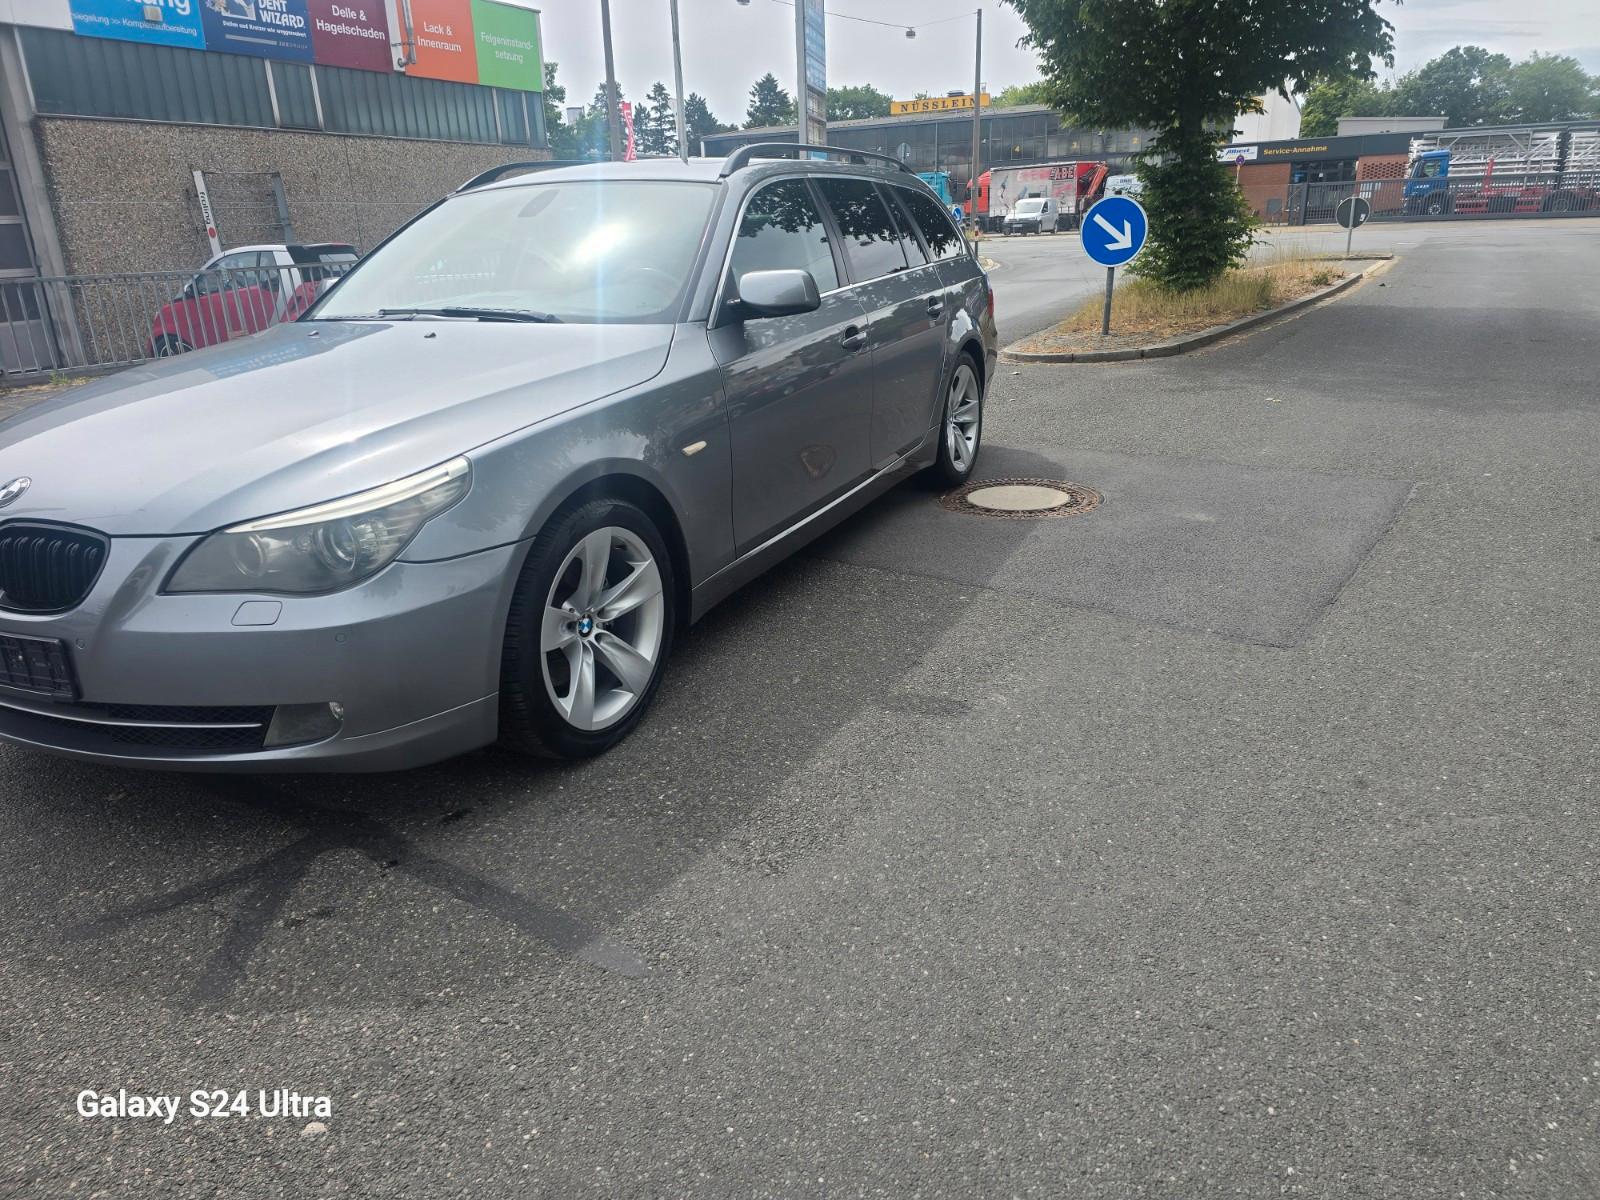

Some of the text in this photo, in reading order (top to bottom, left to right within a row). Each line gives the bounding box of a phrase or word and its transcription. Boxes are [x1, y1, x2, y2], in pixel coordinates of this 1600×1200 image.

[258, 0, 287, 12] DENT
[331, 5, 367, 21] Delle &
[259, 10, 304, 28] WIZARD
[316, 19, 385, 40] Hagelschaden
[423, 21, 453, 36] Lack &
[417, 35, 462, 53] Innenraum
[480, 32, 533, 50] Felgeninstand-
[495, 50, 523, 64] setzung
[901, 98, 976, 112] NÜSSLEIN
[1264, 145, 1328, 156] Service-Annahme
